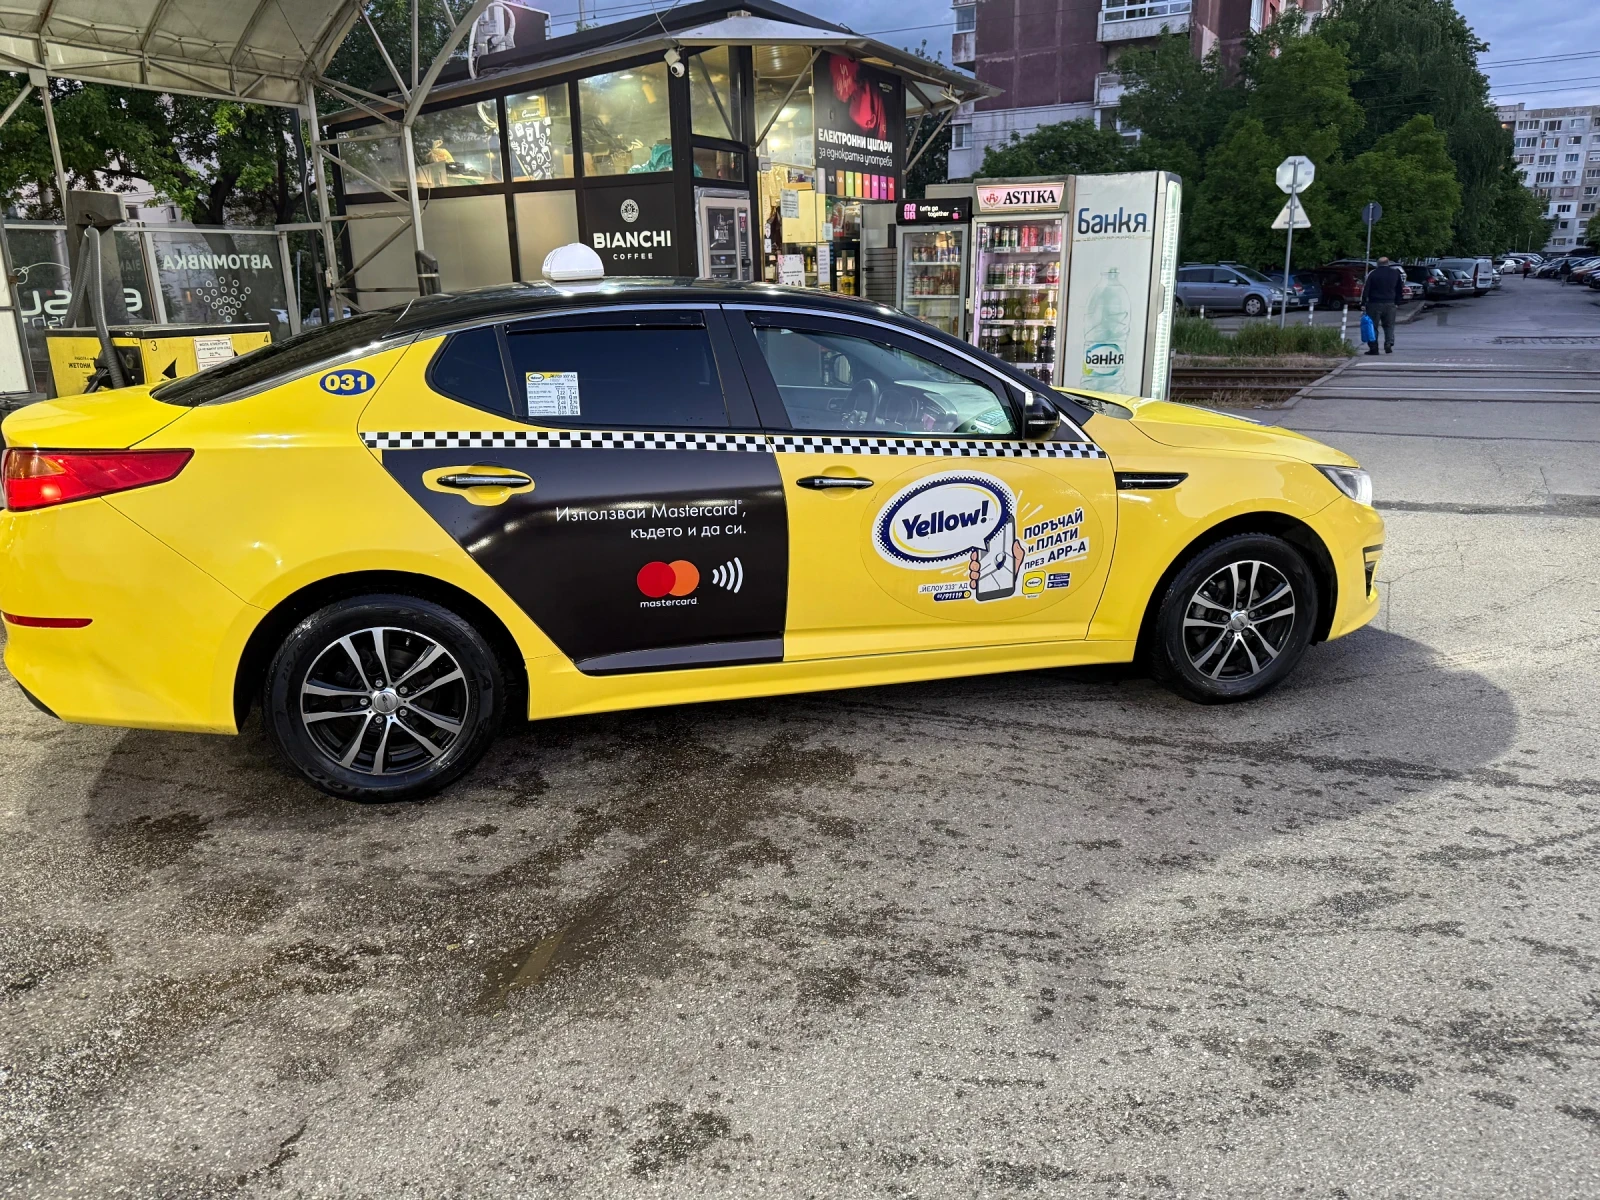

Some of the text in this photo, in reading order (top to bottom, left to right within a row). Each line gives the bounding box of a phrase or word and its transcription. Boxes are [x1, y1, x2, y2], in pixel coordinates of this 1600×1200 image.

[818, 128, 893, 153] ЕЛЕКТРОННИ ЦИГАРИ
[818, 147, 893, 167] за еднократна употреба
[1003, 190, 1057, 205] ASTIKA
[928, 210, 949, 218] together
[593, 230, 672, 249] BIANCHI
[150, 340, 158, 351] 3
[324, 374, 367, 390] 031
[555, 503, 646, 522] Използвай
[902, 500, 990, 540] Yellow!
[630, 523, 747, 540] където и да си.
[1023, 508, 1084, 540] ПОРЪЧАЙ
[1028, 527, 1079, 553] и ПЛАТИ
[1024, 557, 1045, 570] ПРЕЗ
[958, 582, 968, 590] АД
